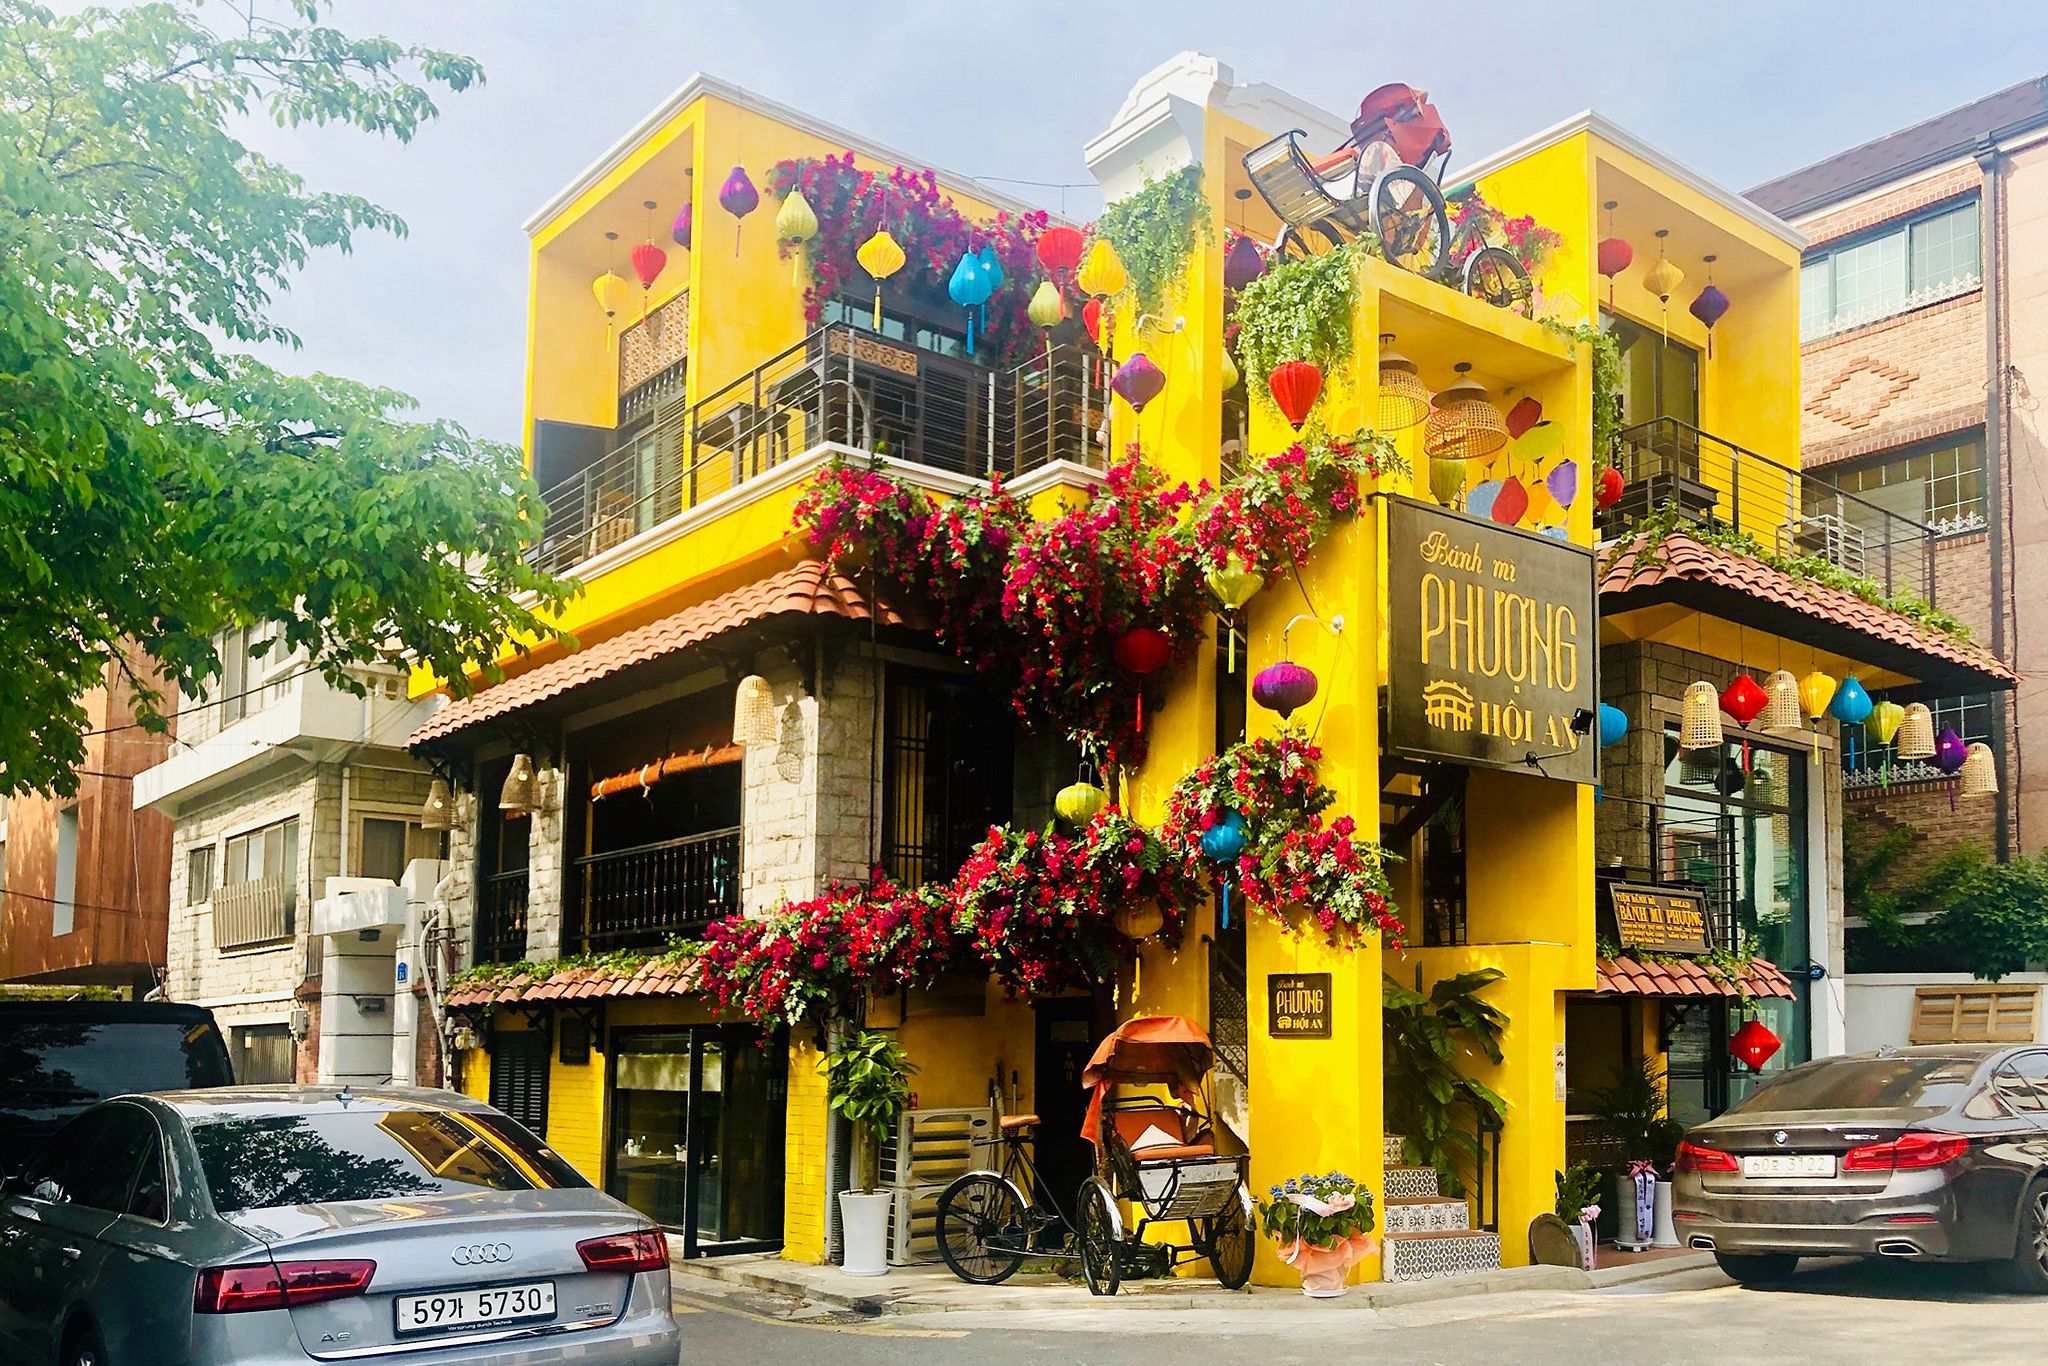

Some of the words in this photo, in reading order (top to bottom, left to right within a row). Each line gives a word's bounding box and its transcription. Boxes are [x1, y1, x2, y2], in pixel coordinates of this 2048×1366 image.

[1420, 530, 1483, 574] Bánh
[1420, 573, 1577, 693] PHƯỢNG
[1480, 700, 1533, 746] HỘI
[1620, 903, 1648, 921] BÁNH
[1276, 990, 1323, 1016] PHƯỢNG
[1293, 1016, 1309, 1030] HỘI
[1310, 1018, 1323, 1029] AN
[413, 1297, 464, 1324] 59가
[478, 1288, 541, 1317] 5730
